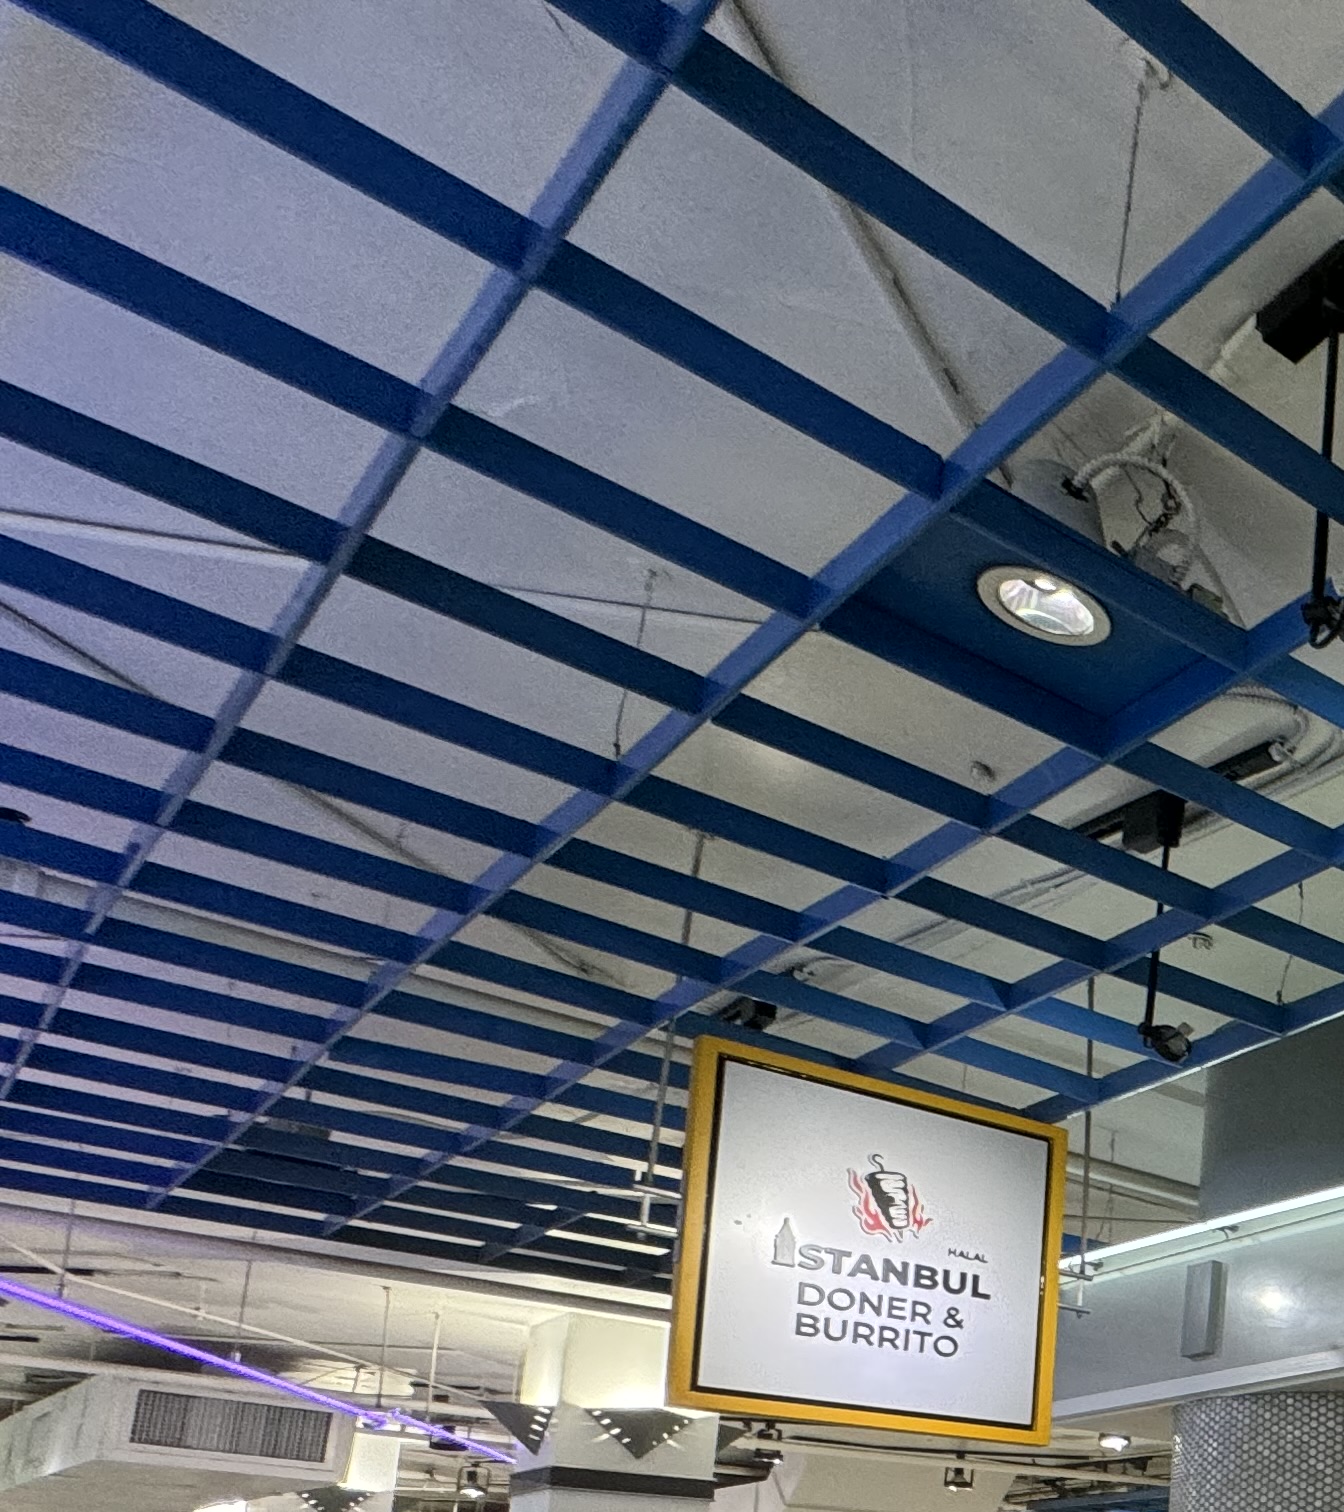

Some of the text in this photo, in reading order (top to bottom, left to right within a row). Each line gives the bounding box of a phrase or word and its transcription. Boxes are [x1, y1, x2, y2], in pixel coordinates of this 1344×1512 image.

[947, 1247, 989, 1263] HALAL
[796, 1281, 965, 1329] DONER &
[795, 1312, 959, 1358] BURRITO
